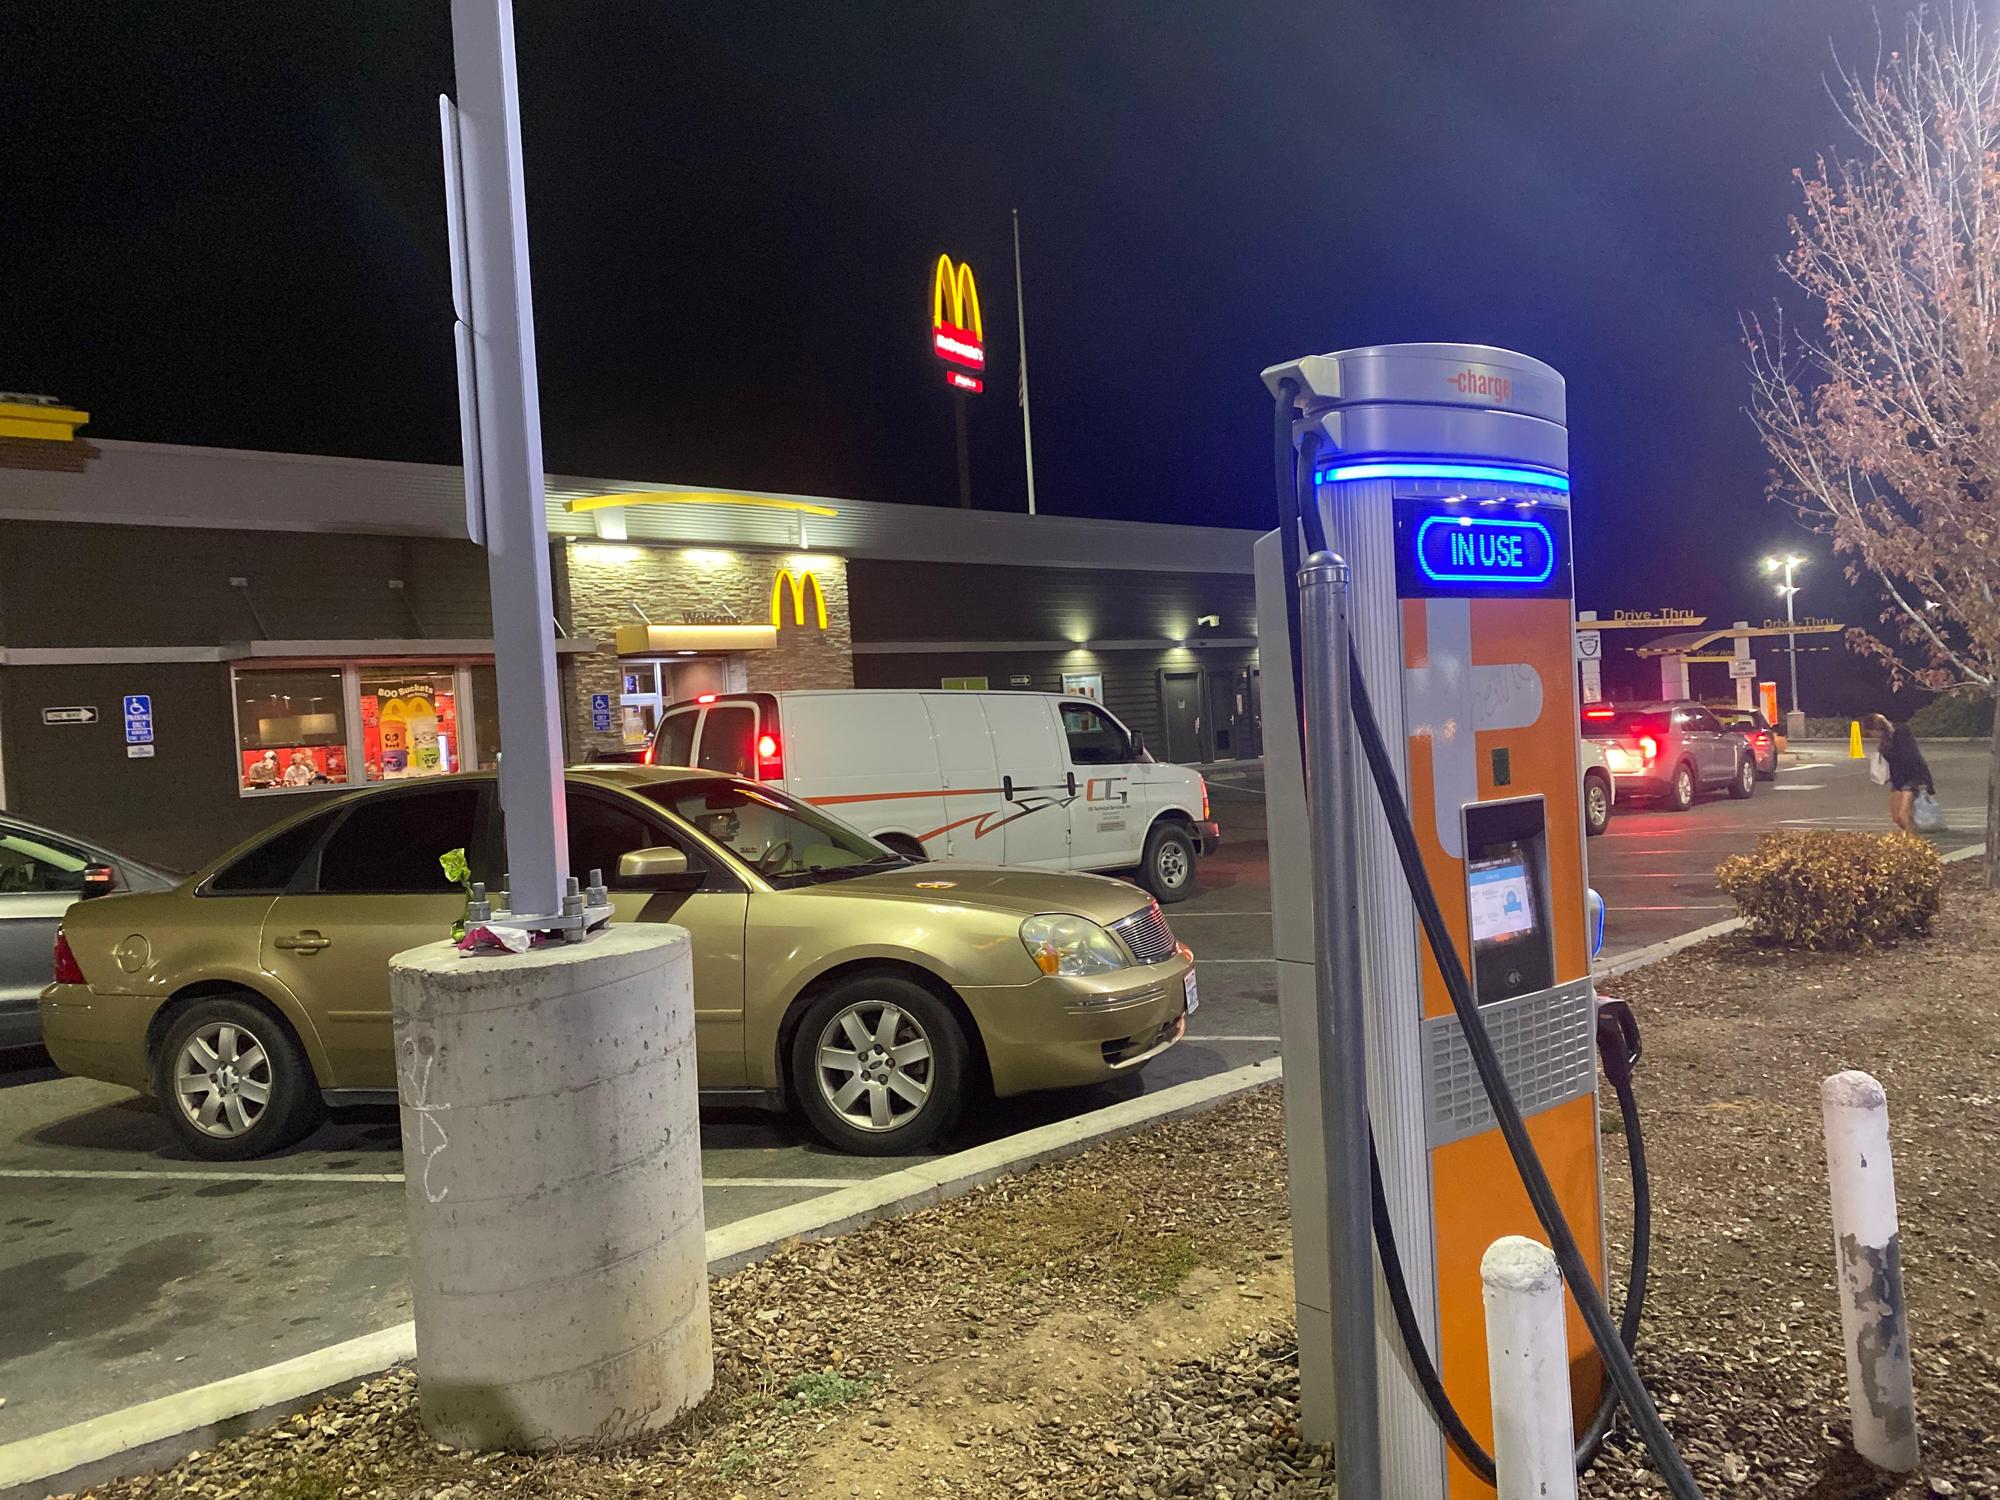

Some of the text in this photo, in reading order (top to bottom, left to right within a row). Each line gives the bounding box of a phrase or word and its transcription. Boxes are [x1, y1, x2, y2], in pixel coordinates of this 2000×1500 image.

[1451, 532, 1523, 567] IN USE
[682, 611, 742, 625] Welcome
[378, 688, 398, 698] BOO
[398, 684, 434, 696] Buckets
